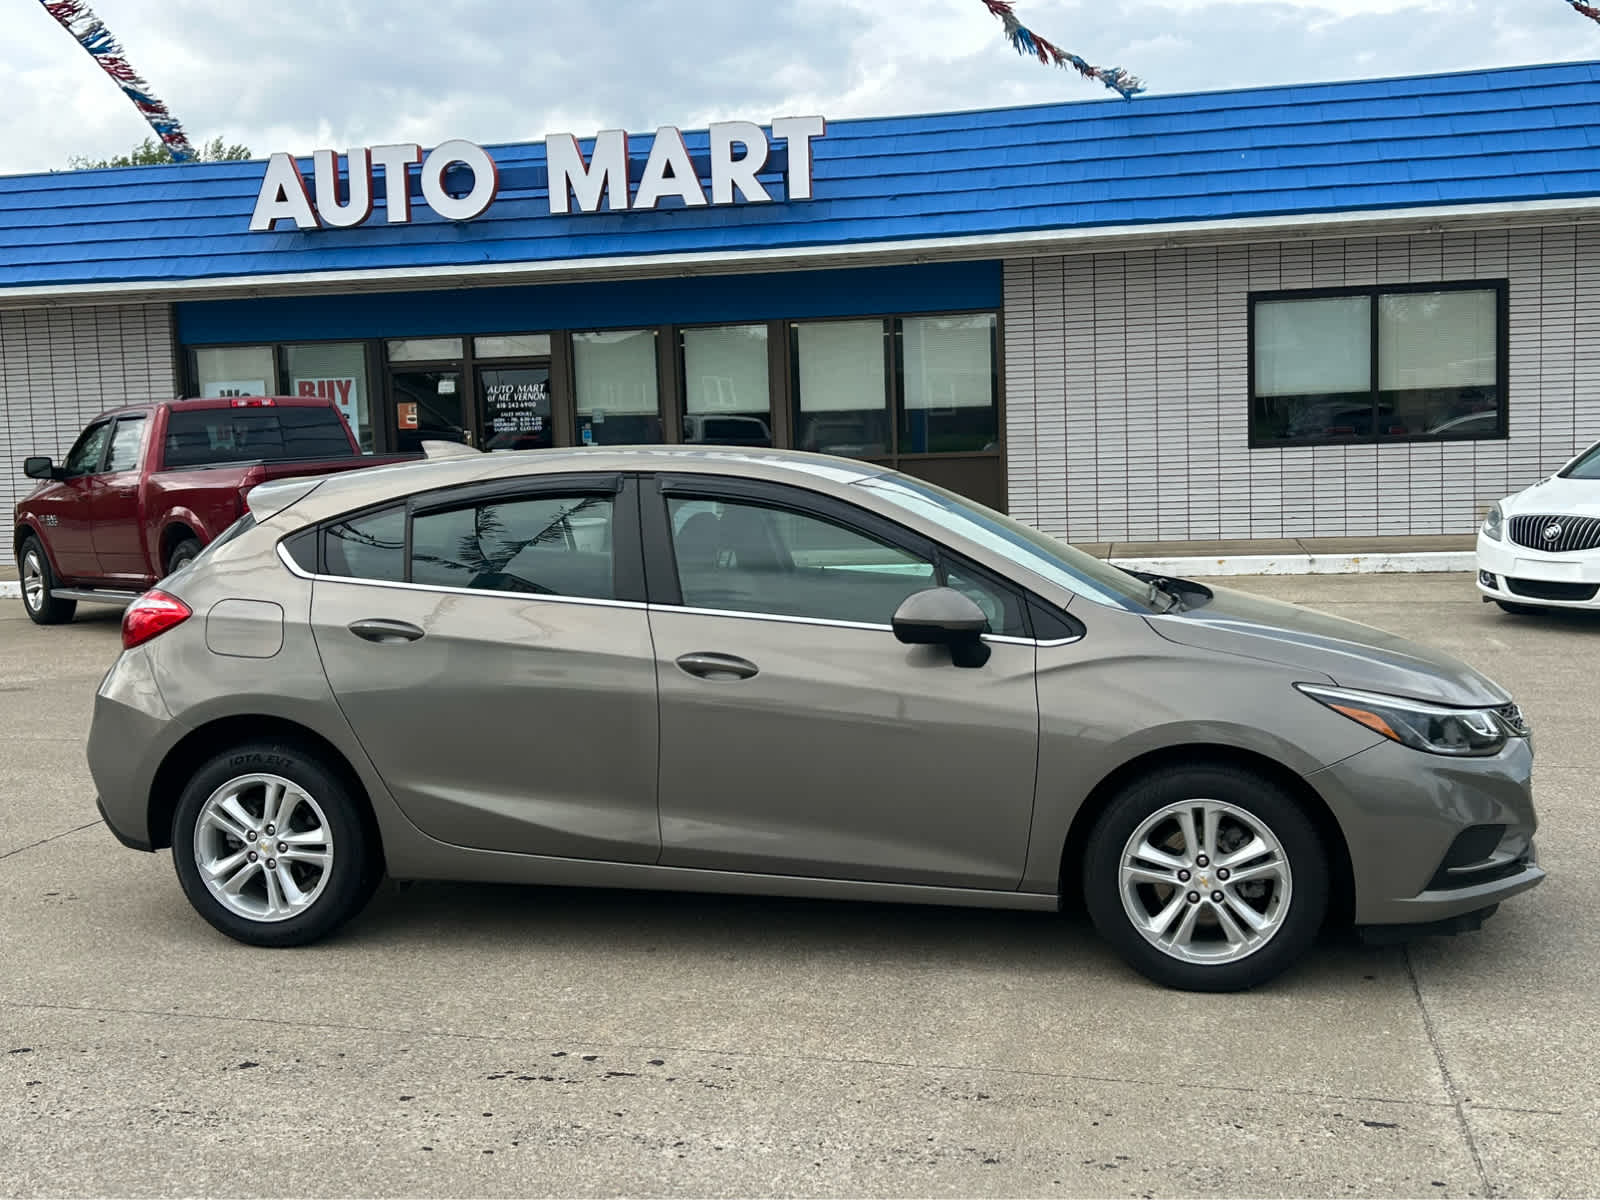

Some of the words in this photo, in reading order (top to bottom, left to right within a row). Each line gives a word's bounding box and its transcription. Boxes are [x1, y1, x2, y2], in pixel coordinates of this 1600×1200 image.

[249, 139, 498, 231] AUTO
[545, 116, 826, 213] MART
[298, 380, 352, 406] BUY
[487, 385, 514, 393] AUTO
[517, 384, 545, 392] MART
[513, 392, 546, 401] VERNON
